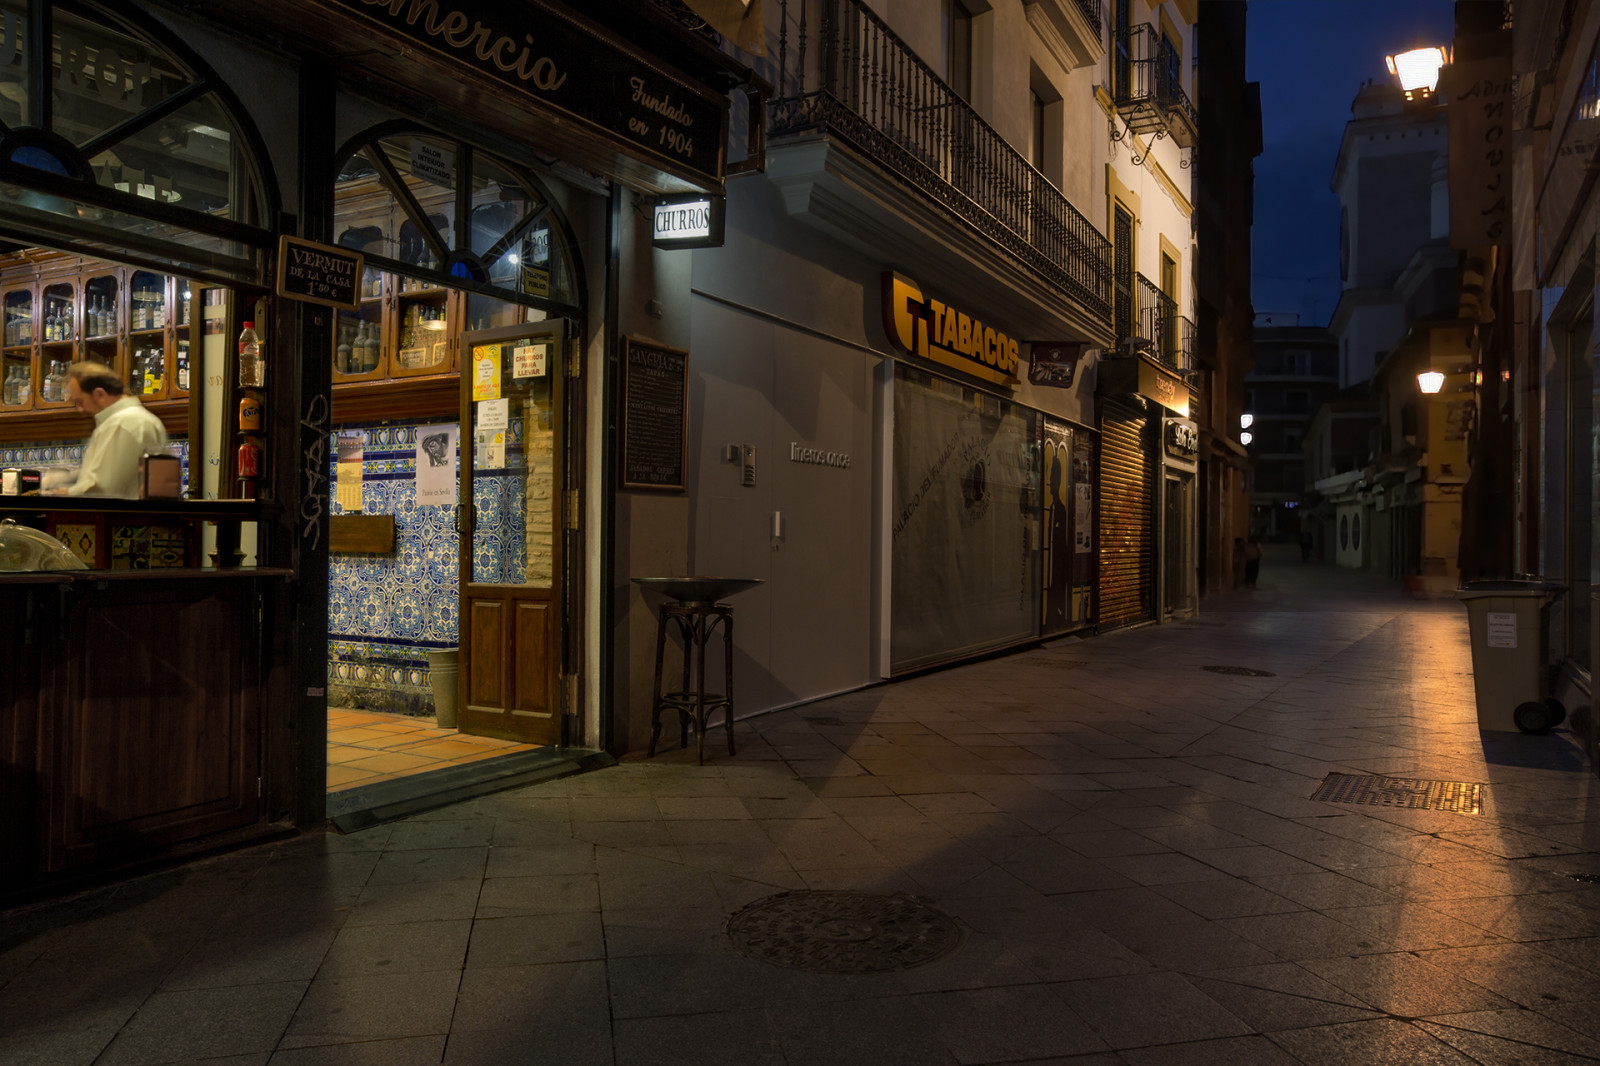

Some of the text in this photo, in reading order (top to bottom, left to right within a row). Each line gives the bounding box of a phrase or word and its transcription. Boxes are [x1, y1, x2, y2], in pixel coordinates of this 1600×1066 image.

[360, 0, 567, 91] mercio
[629, 76, 694, 127] Fundado
[628, 116, 694, 158] en 1904
[411, 160, 450, 180] CLIMATIZADO
[417, 154, 446, 169] INTERIOR
[655, 207, 709, 233] CHURROS
[290, 247, 355, 275] VERMUT
[289, 265, 352, 288] DE LA CASA
[929, 299, 1020, 374] TABACOS
[515, 353, 544, 362] CHURROS
[523, 346, 536, 355] HAY
[518, 368, 541, 377] LLEVAR
[521, 361, 537, 369] PARA
[892, 493, 920, 543] PALACIO
